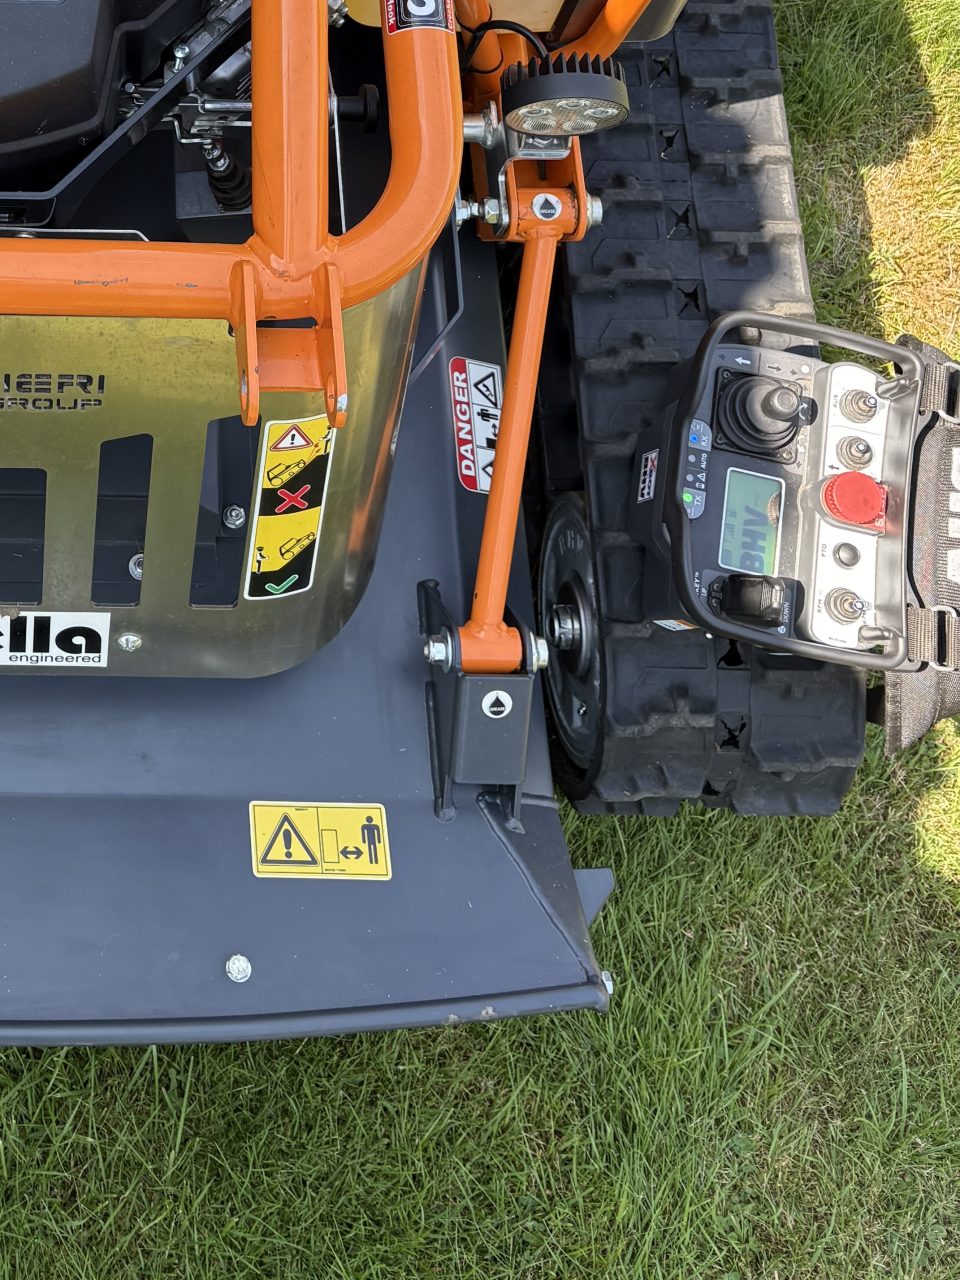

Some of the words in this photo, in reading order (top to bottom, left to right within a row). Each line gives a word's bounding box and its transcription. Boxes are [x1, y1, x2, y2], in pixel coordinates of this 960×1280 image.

[453, 371, 476, 477] DANGER
[700, 452, 708, 469] AUTO
[739, 505, 770, 574] BHV
[9, 653, 102, 665] engineered
